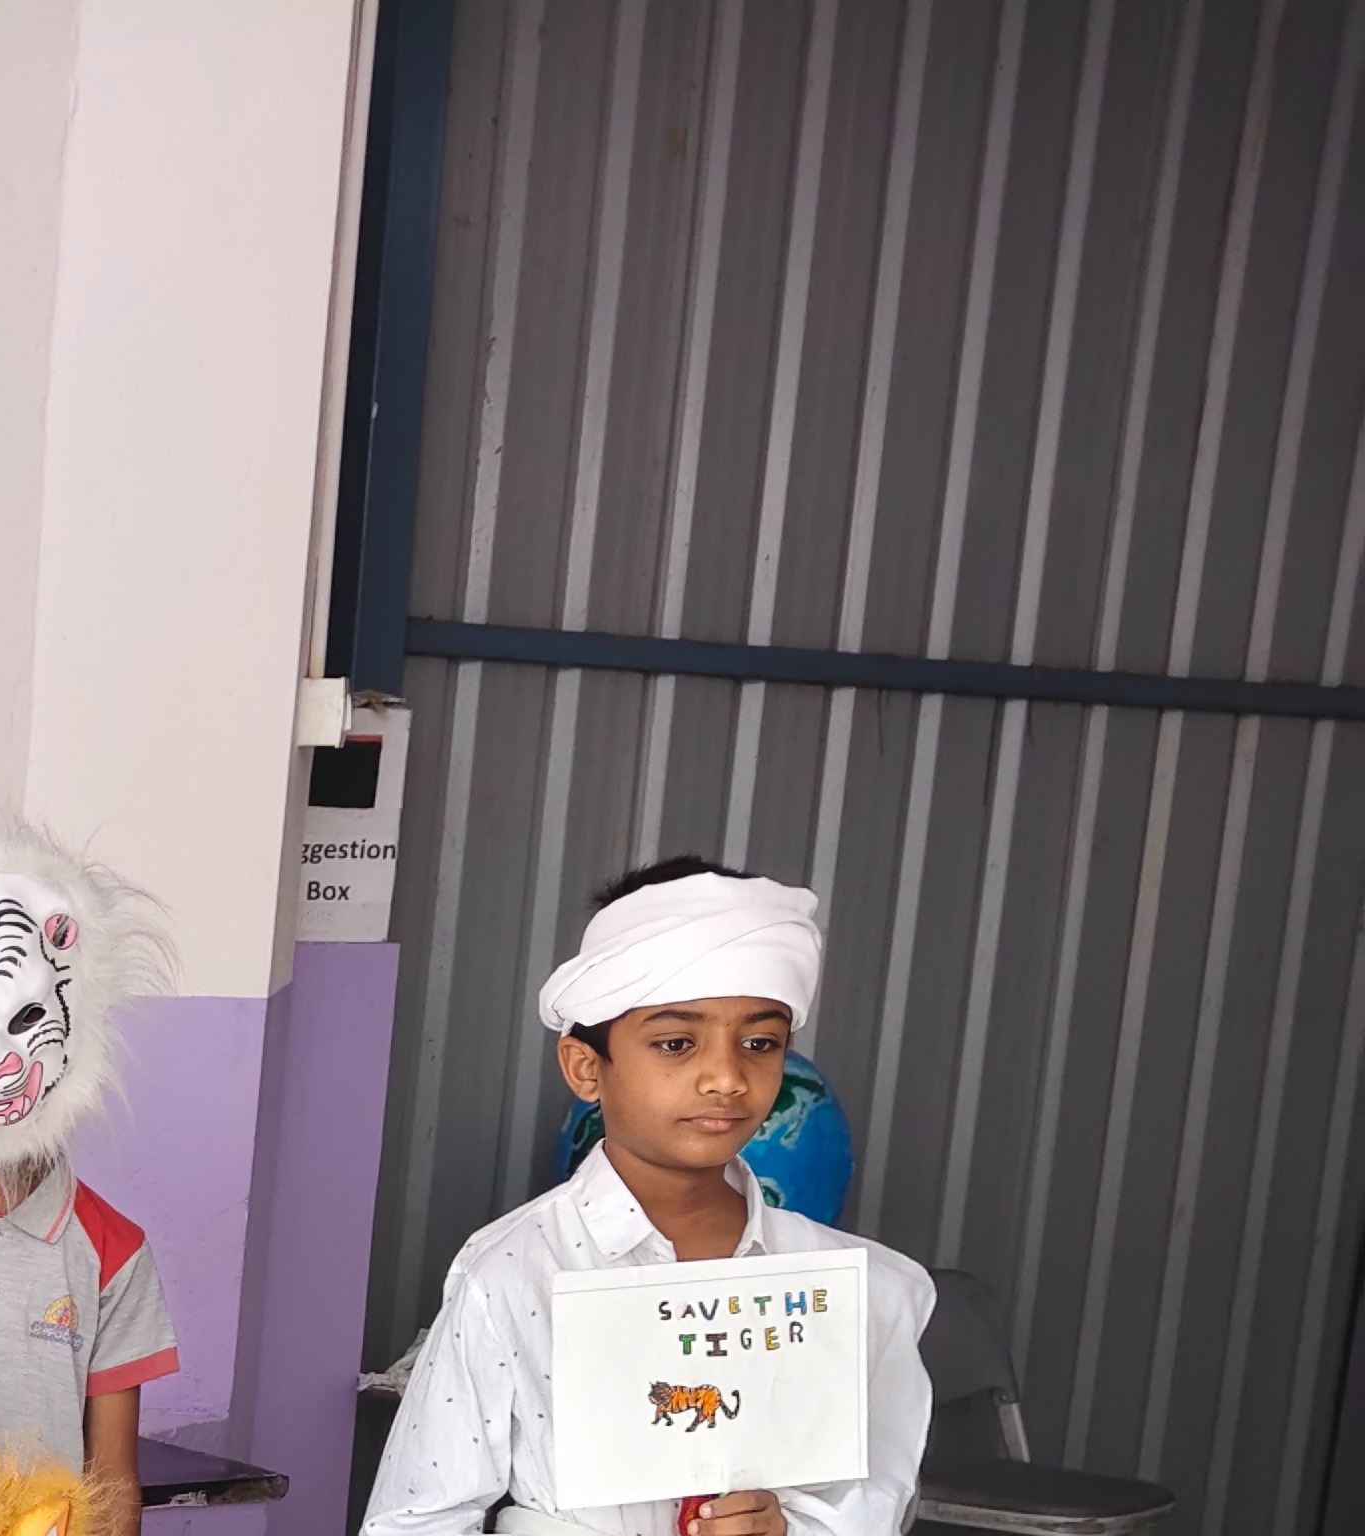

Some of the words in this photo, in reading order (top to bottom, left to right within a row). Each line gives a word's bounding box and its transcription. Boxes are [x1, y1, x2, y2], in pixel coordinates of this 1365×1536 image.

[301, 838, 396, 864] ggestion
[306, 881, 350, 901] Box
[678, 1320, 804, 1357] TIGER
